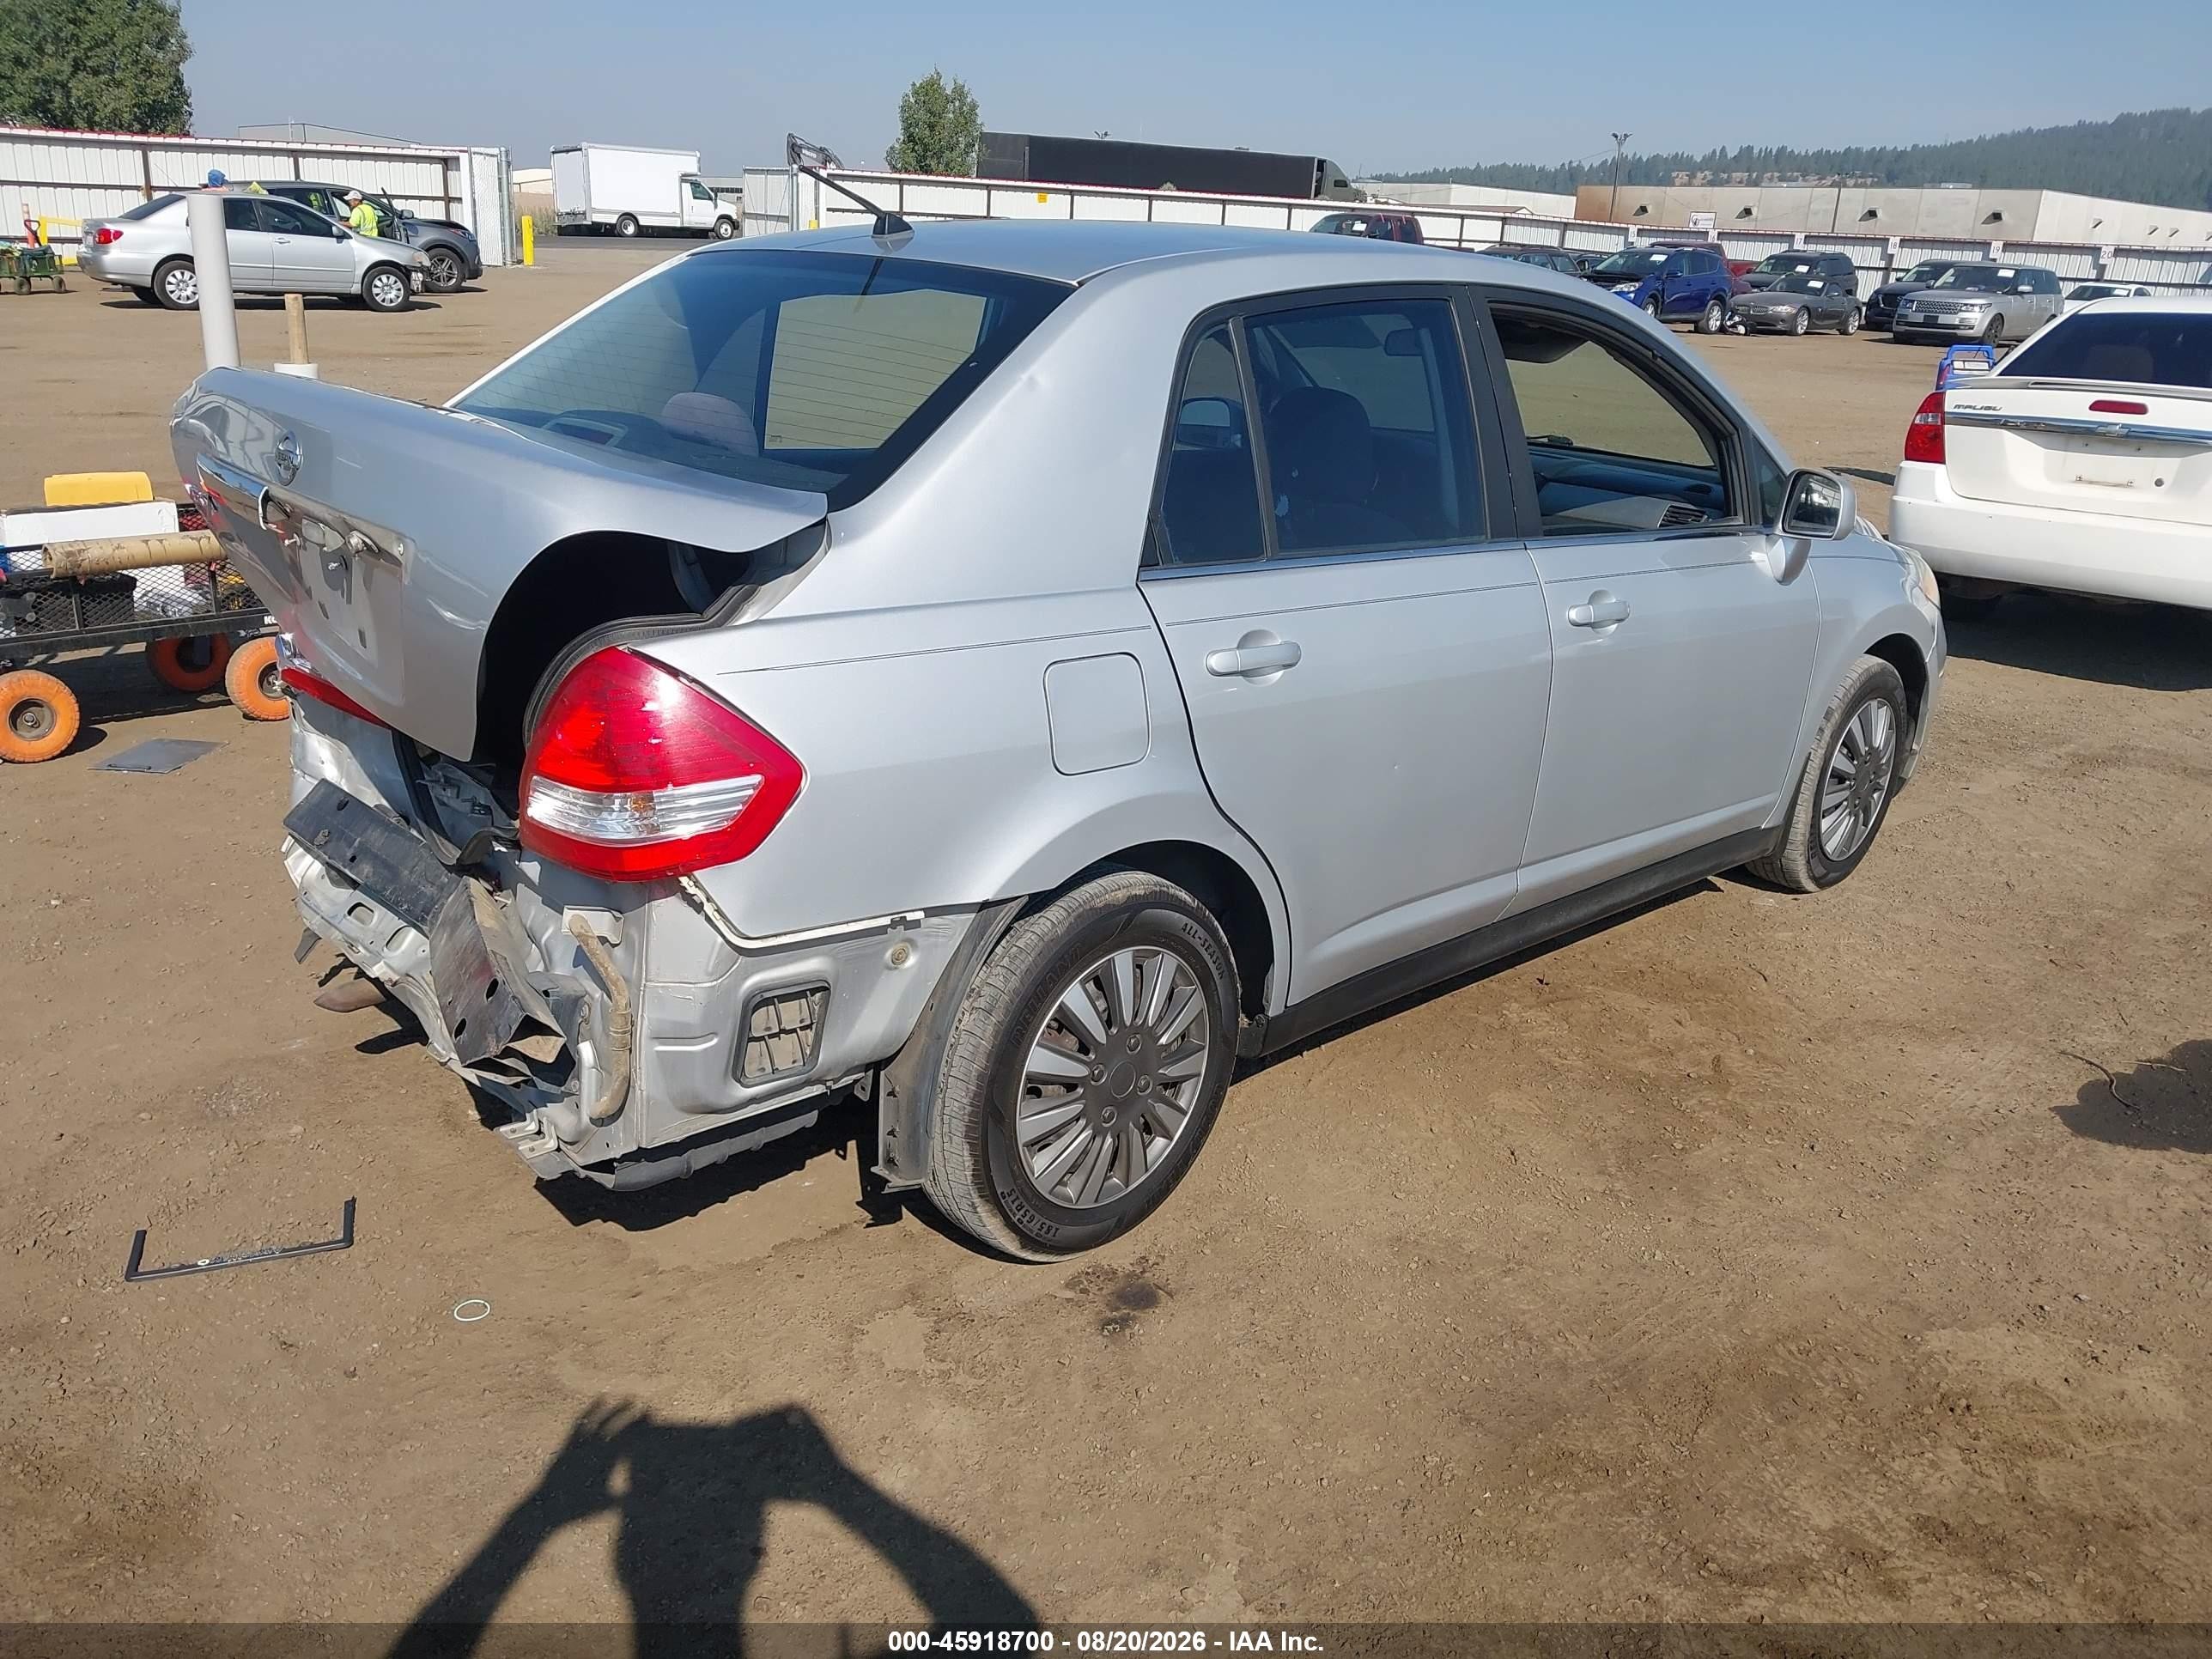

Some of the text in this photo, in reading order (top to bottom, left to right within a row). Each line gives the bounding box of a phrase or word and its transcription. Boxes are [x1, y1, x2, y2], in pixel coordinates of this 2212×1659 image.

[1890, 241, 1897, 250] 18
[1992, 246, 2000, 254] 19
[2101, 250, 2112, 258] 20
[1182, 922, 1224, 980] ALL-SEASON
[1006, 1188, 1060, 1237] 185/65R15
